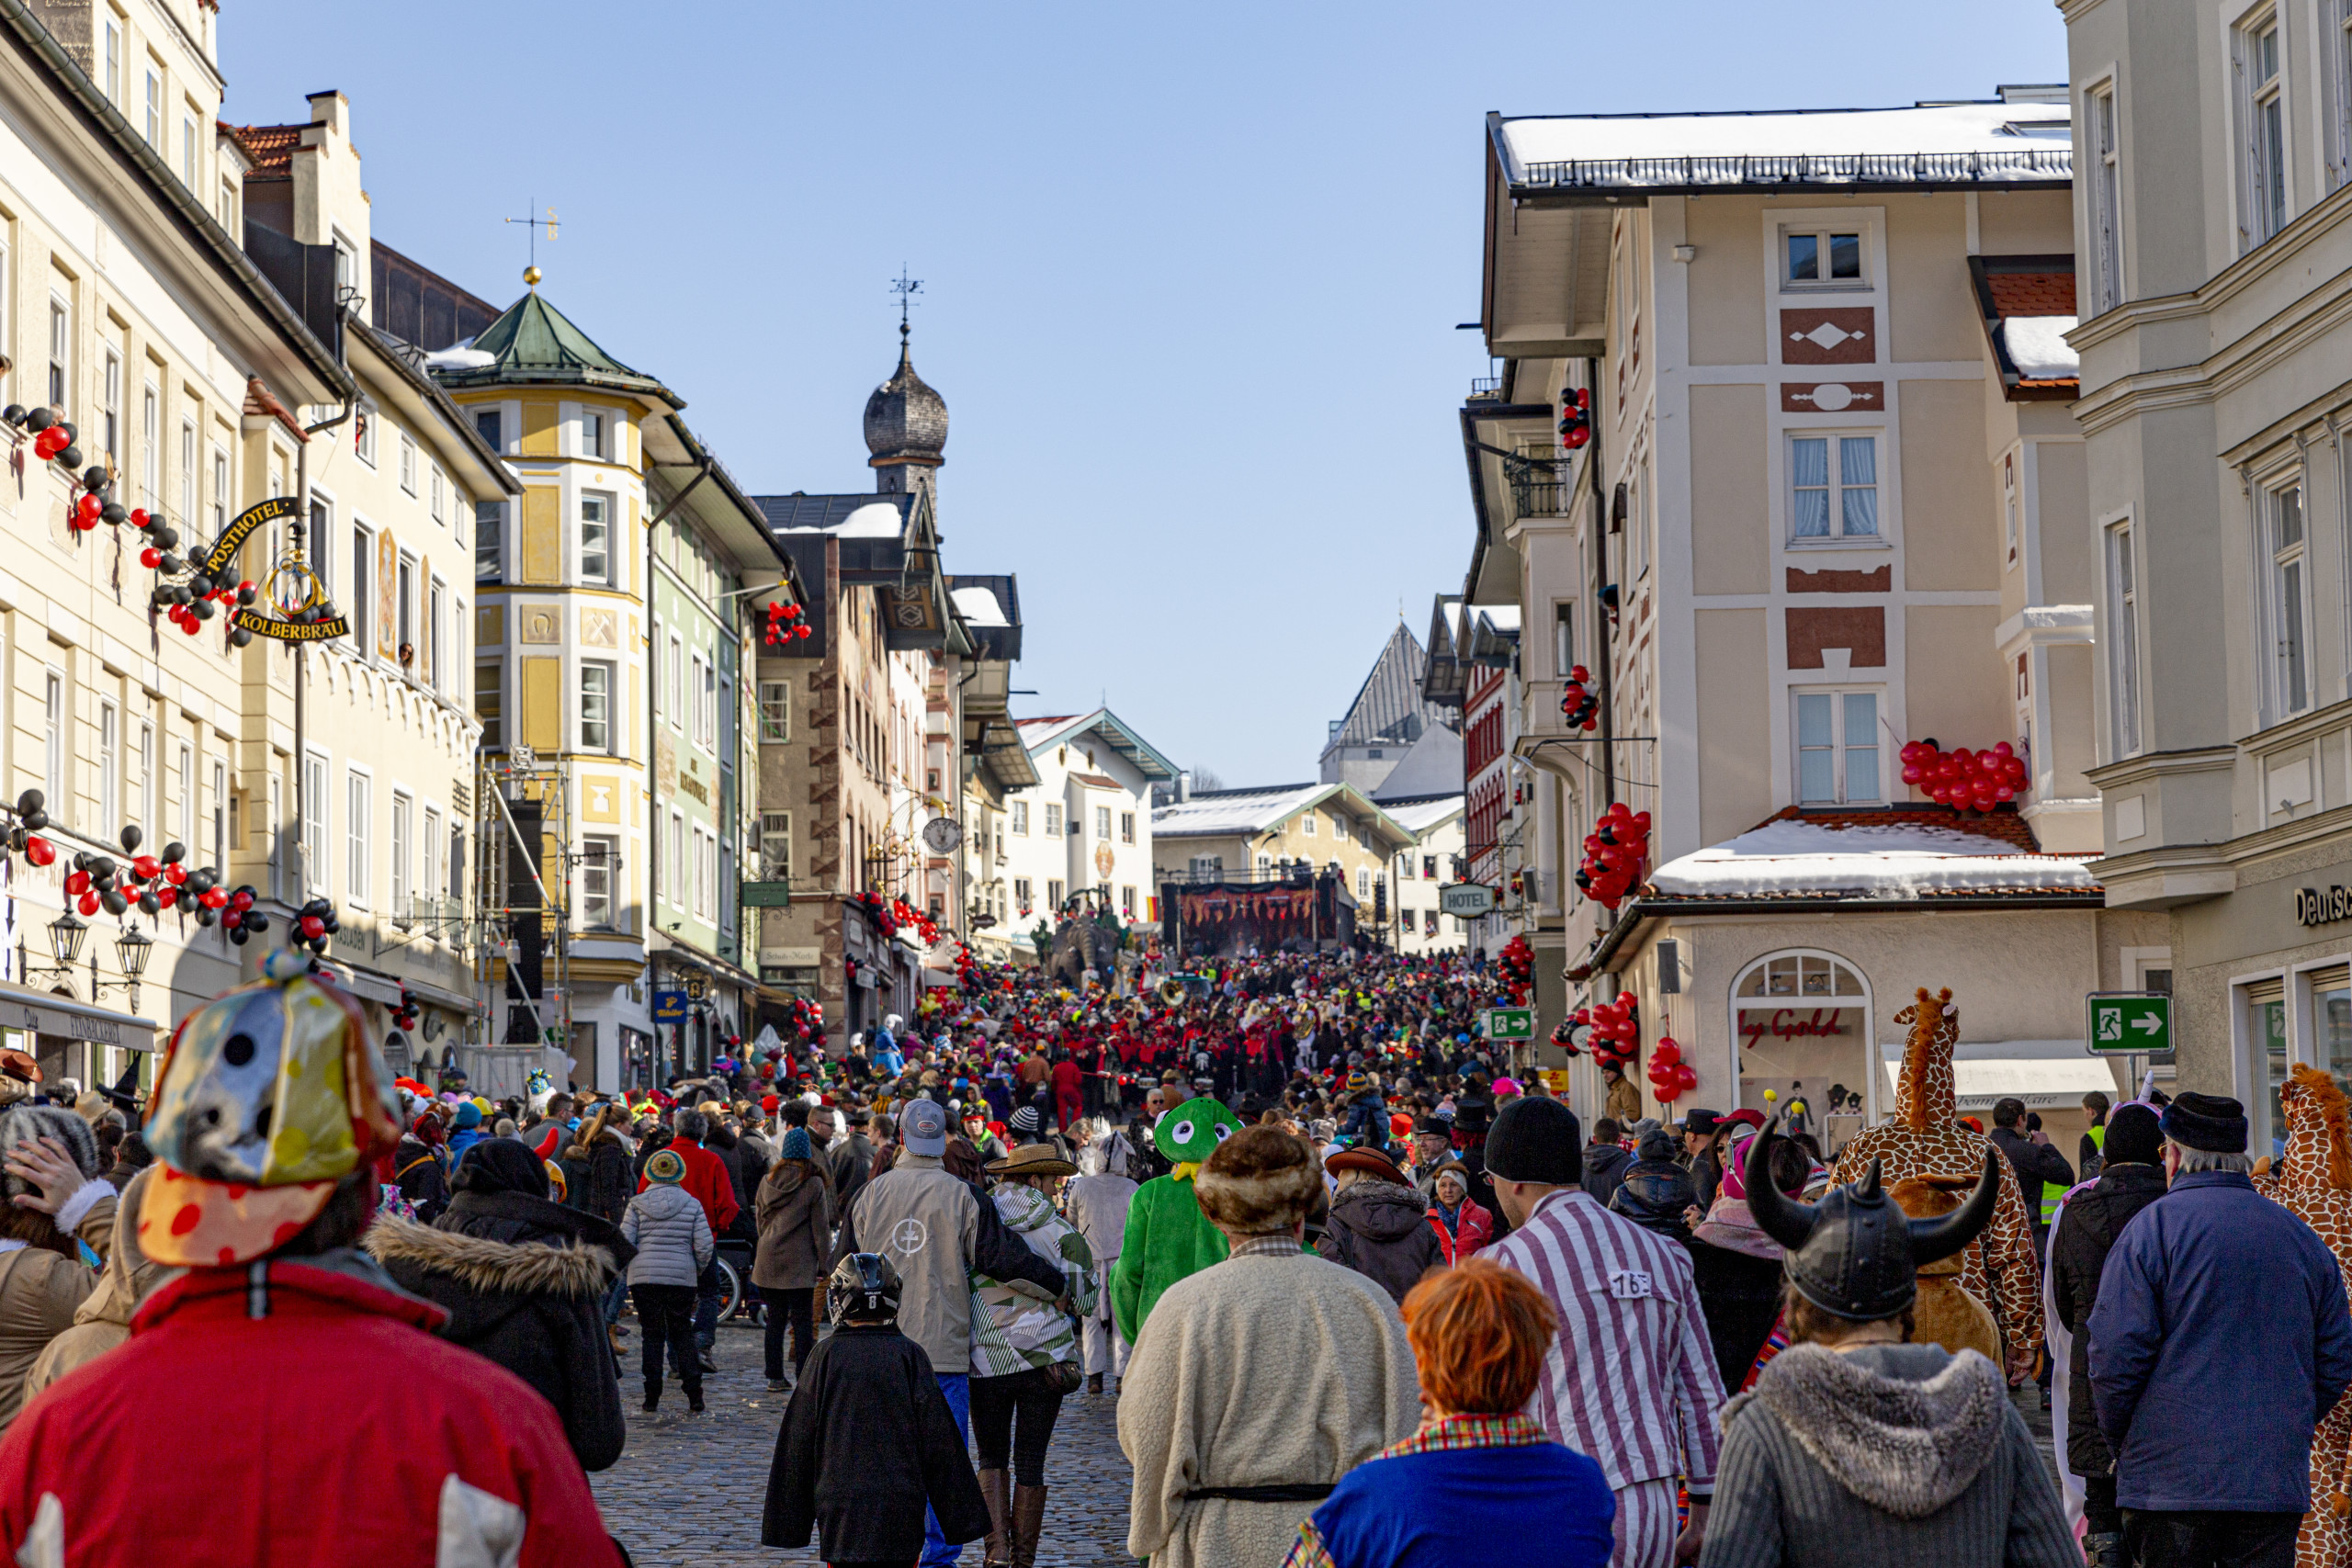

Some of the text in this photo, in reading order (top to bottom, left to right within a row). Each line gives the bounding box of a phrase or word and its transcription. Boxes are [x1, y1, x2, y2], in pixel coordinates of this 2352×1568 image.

[207, 501, 284, 572] POSTHOTEL
[239, 612, 344, 639] KOLBERBRÄU
[1447, 892, 1488, 908] HOTEL
[2294, 886, 2352, 926] Deutsc
[1771, 1008, 1841, 1042] Gold
[2020, 1093, 2057, 1105] ffaire
[869, 1295, 876, 1309] 8
